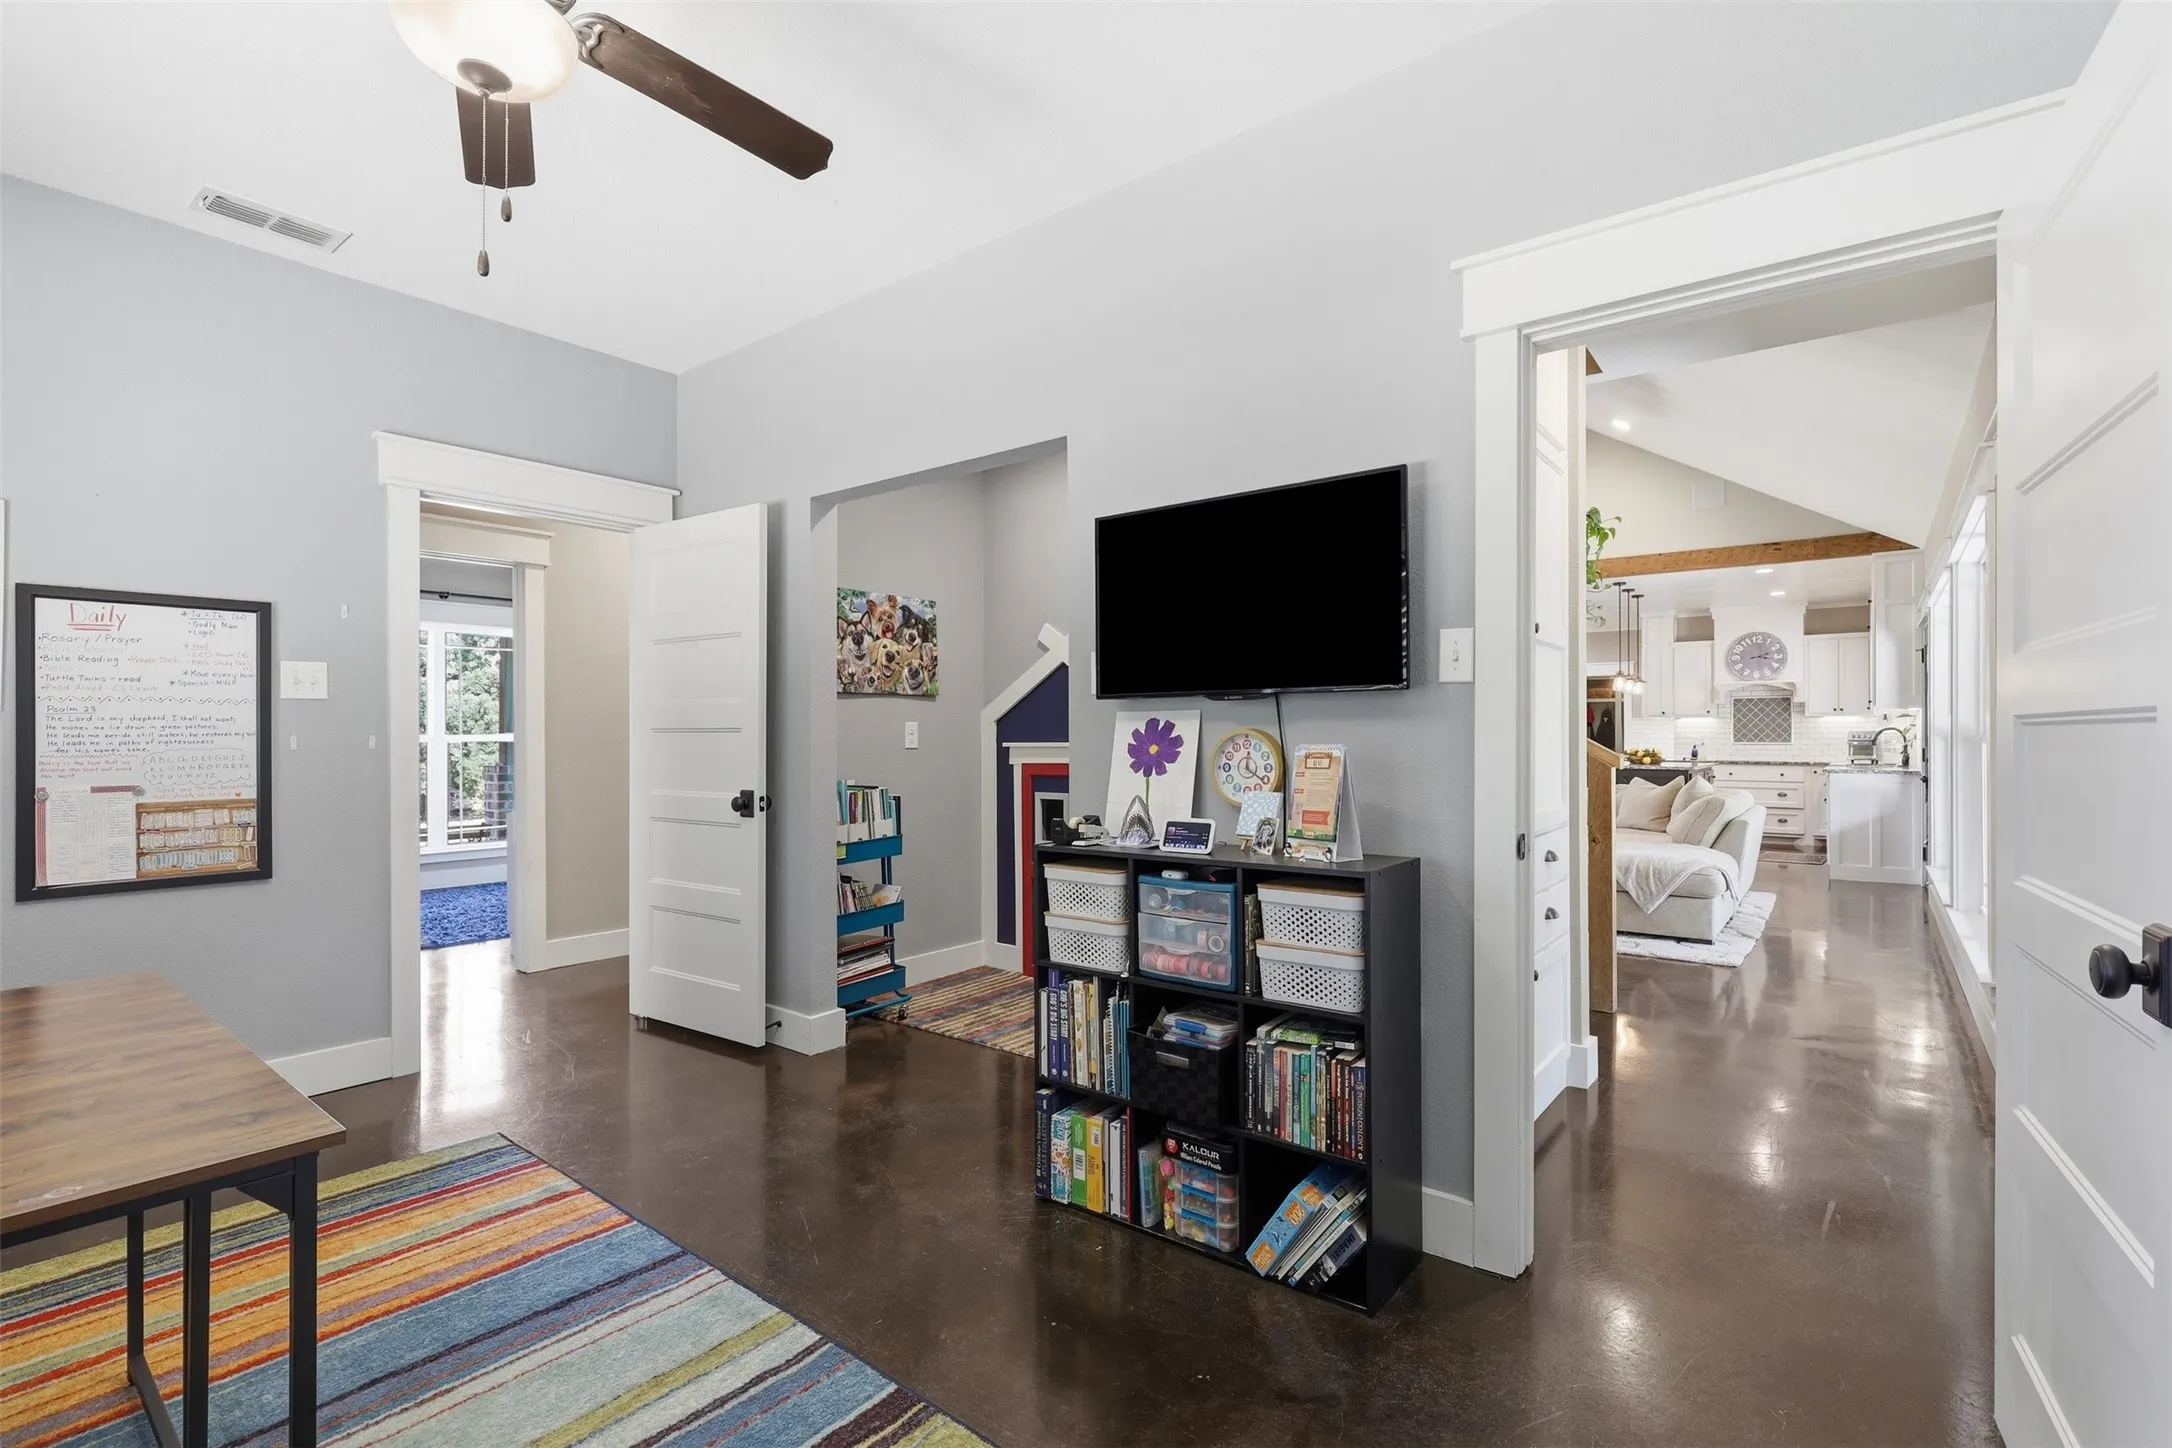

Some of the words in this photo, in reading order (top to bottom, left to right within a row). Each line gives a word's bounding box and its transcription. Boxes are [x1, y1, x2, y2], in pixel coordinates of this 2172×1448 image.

[70, 602, 127, 631] Daily
[41, 633, 90, 647] Rosary
[104, 634, 143, 646] Prayer
[1741, 638, 1752, 648] 11
[1752, 635, 1762, 643] 12
[1733, 644, 1744, 654] 10
[1771, 643, 1780, 651] 2
[42, 654, 72, 662] Bible
[78, 655, 119, 667] Reading
[45, 674, 75, 683] Tuttle
[78, 674, 107, 683] Twins
[118, 675, 142, 683] read
[1753, 670, 1760, 679] 6
[46, 704, 78, 713] Psalm
[83, 705, 97, 713] 23
[68, 714, 93, 722] Lord
[109, 716, 124, 724] my
[45, 723, 57, 731] He
[1182, 1142, 1220, 1160] KALOUR
